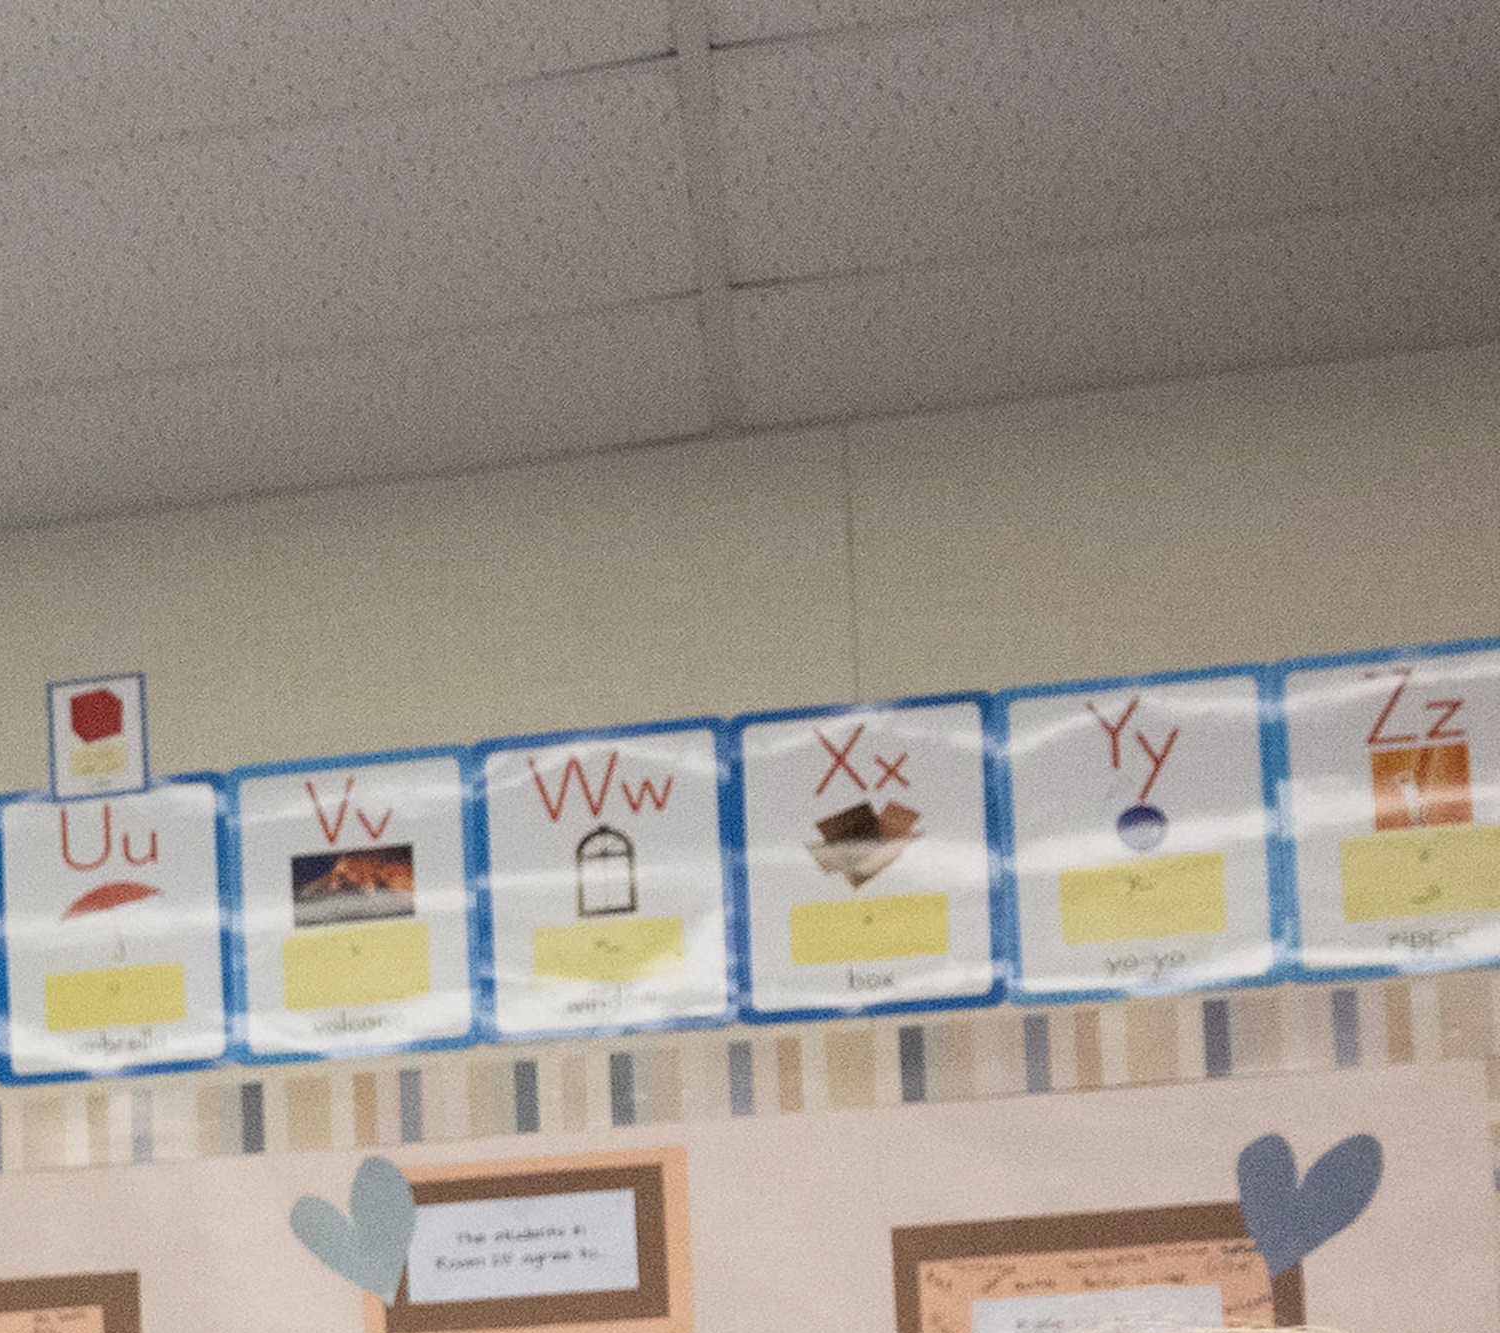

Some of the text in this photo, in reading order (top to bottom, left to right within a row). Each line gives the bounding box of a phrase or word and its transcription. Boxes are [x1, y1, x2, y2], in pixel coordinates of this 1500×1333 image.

[1363, 666, 1467, 746] Zz
[815, 724, 909, 795] Xx
[1086, 697, 1179, 801] Yy
[306, 777, 392, 845] Vv
[528, 751, 674, 822] Ww
[61, 804, 159, 871] Uu
[846, 965, 894, 991] box
